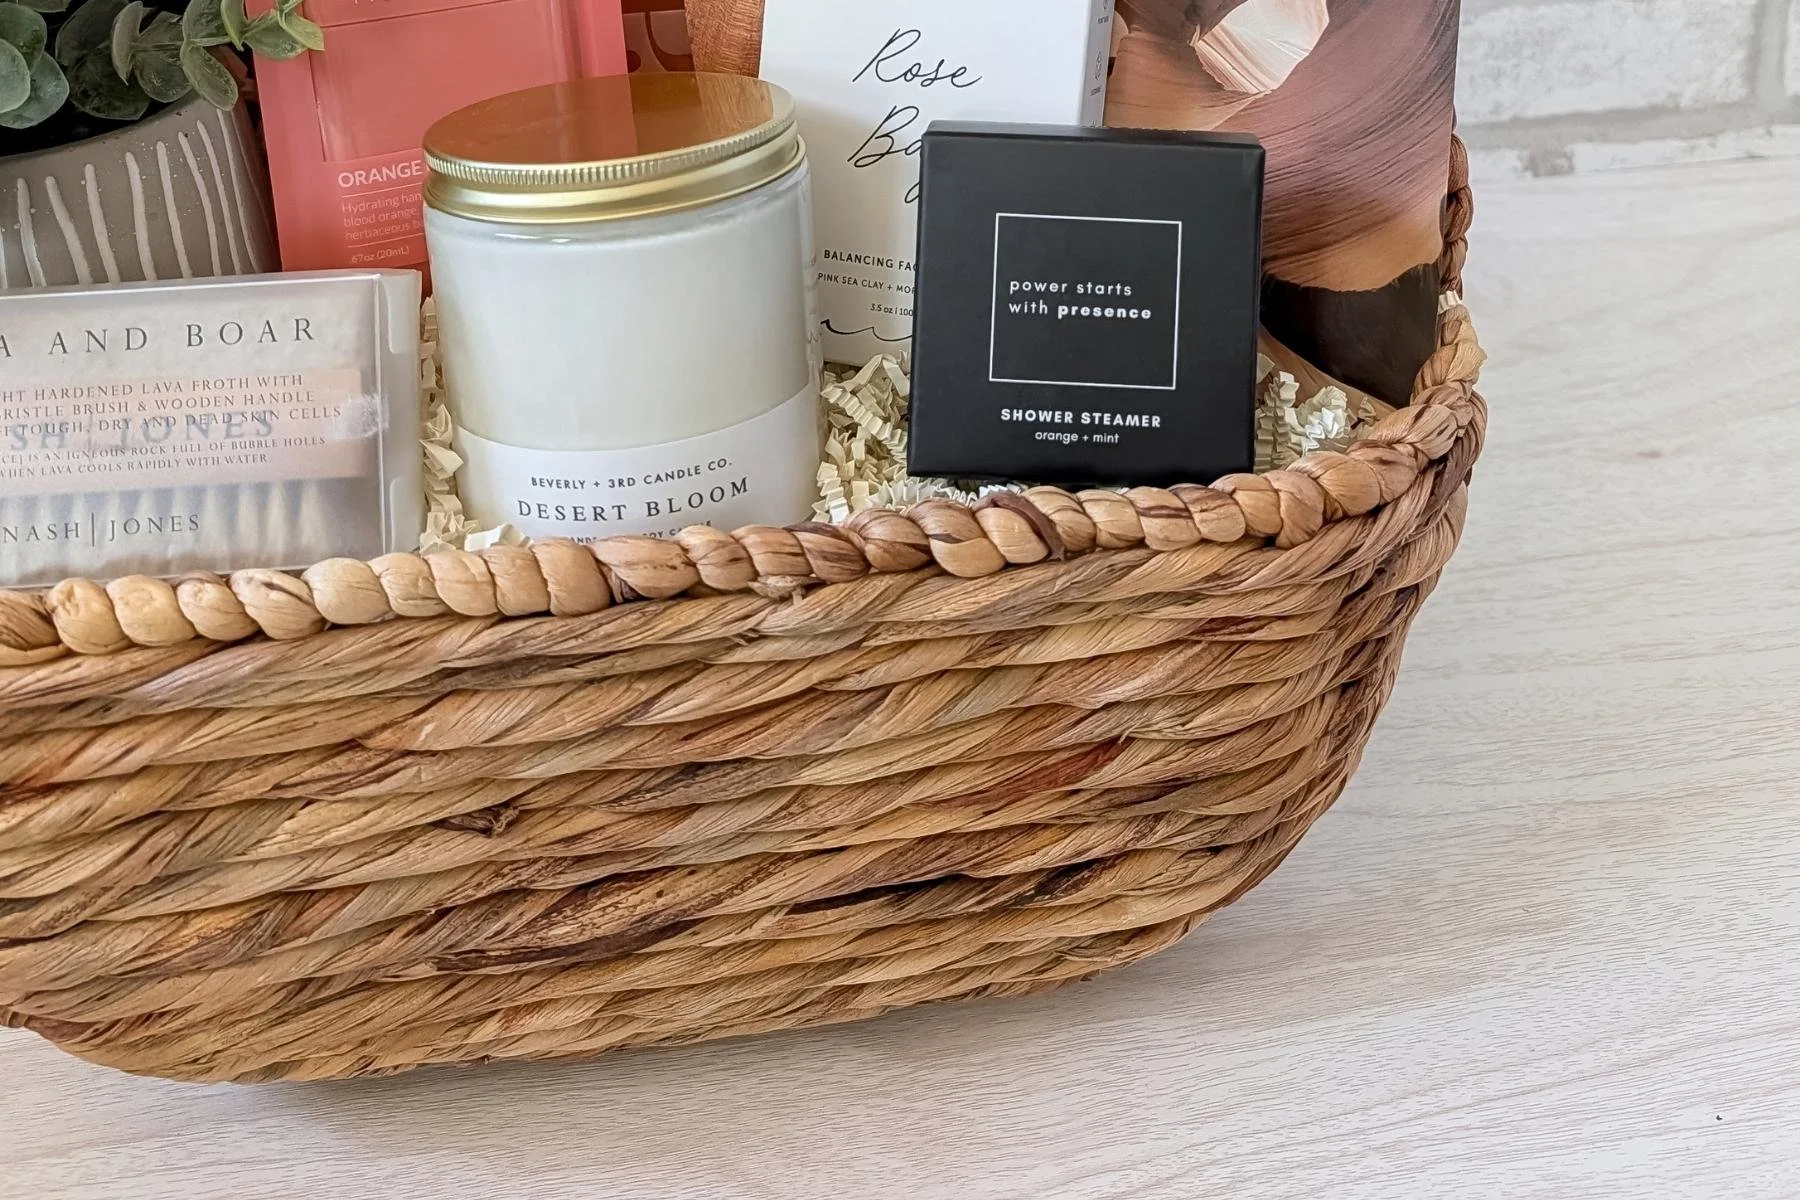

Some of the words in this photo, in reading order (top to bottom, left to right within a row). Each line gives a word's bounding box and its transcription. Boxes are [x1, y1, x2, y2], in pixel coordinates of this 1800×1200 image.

[852, 28, 982, 88] Rose
[337, 160, 424, 187] ORANGE
[341, 196, 400, 214] Hydrating
[401, 192, 422, 203] han
[343, 213, 375, 227] blood
[379, 206, 417, 222] orange
[345, 222, 410, 240] herbaceous
[823, 249, 894, 268] BALANCING
[818, 273, 839, 284] PINK
[842, 276, 858, 286] SEA
[861, 279, 884, 289] CLAY
[1009, 280, 1068, 295] power
[1076, 281, 1132, 296] starts
[1009, 300, 1048, 315] with
[1057, 304, 1151, 320] presence
[48, 326, 148, 355] AND
[186, 317, 315, 347] BOAR
[35, 384, 133, 401] HARDENED
[142, 381, 183, 394] LAVA
[192, 377, 249, 392] FROTH
[256, 374, 303, 388] WITH
[0, 406, 64, 420] RISTLE
[73, 401, 128, 415] BRUSH
[137, 401, 148, 412] &
[155, 396, 235, 410] WOODEN
[244, 391, 315, 405] HANDLE
[99, 418, 132, 431] DRY
[141, 415, 177, 429] AND
[185, 412, 232, 426] DEAD
[241, 409, 279, 423] SKIN
[289, 407, 342, 420] CELLS
[1001, 408, 1074, 424] SHOWER
[1081, 412, 1161, 428] STEAMER
[1035, 430, 1078, 444] orange
[1093, 432, 1119, 443] mint
[28, 452, 39, 462] IS
[45, 451, 61, 461] AN
[67, 446, 126, 461] IGNEOUS
[131, 446, 166, 456] ROCK
[173, 442, 201, 452] FULL
[209, 442, 226, 451] OF
[231, 438, 278, 450] BUBBLE
[284, 437, 326, 447] HOLES
[41, 465, 73, 476] LAVA
[78, 463, 122, 474] COOLS
[127, 459, 181, 471] RAPIDLY
[186, 456, 220, 467] WITH
[531, 476, 585, 490] BEVERLY
[608, 477, 636, 488] 3RD
[643, 464, 701, 485] CANDLE
[707, 457, 732, 471] CO.
[517, 500, 627, 522] DESERT
[646, 476, 749, 518] BLOOM
[2, 522, 80, 544] NASH
[109, 514, 200, 542] JONES
